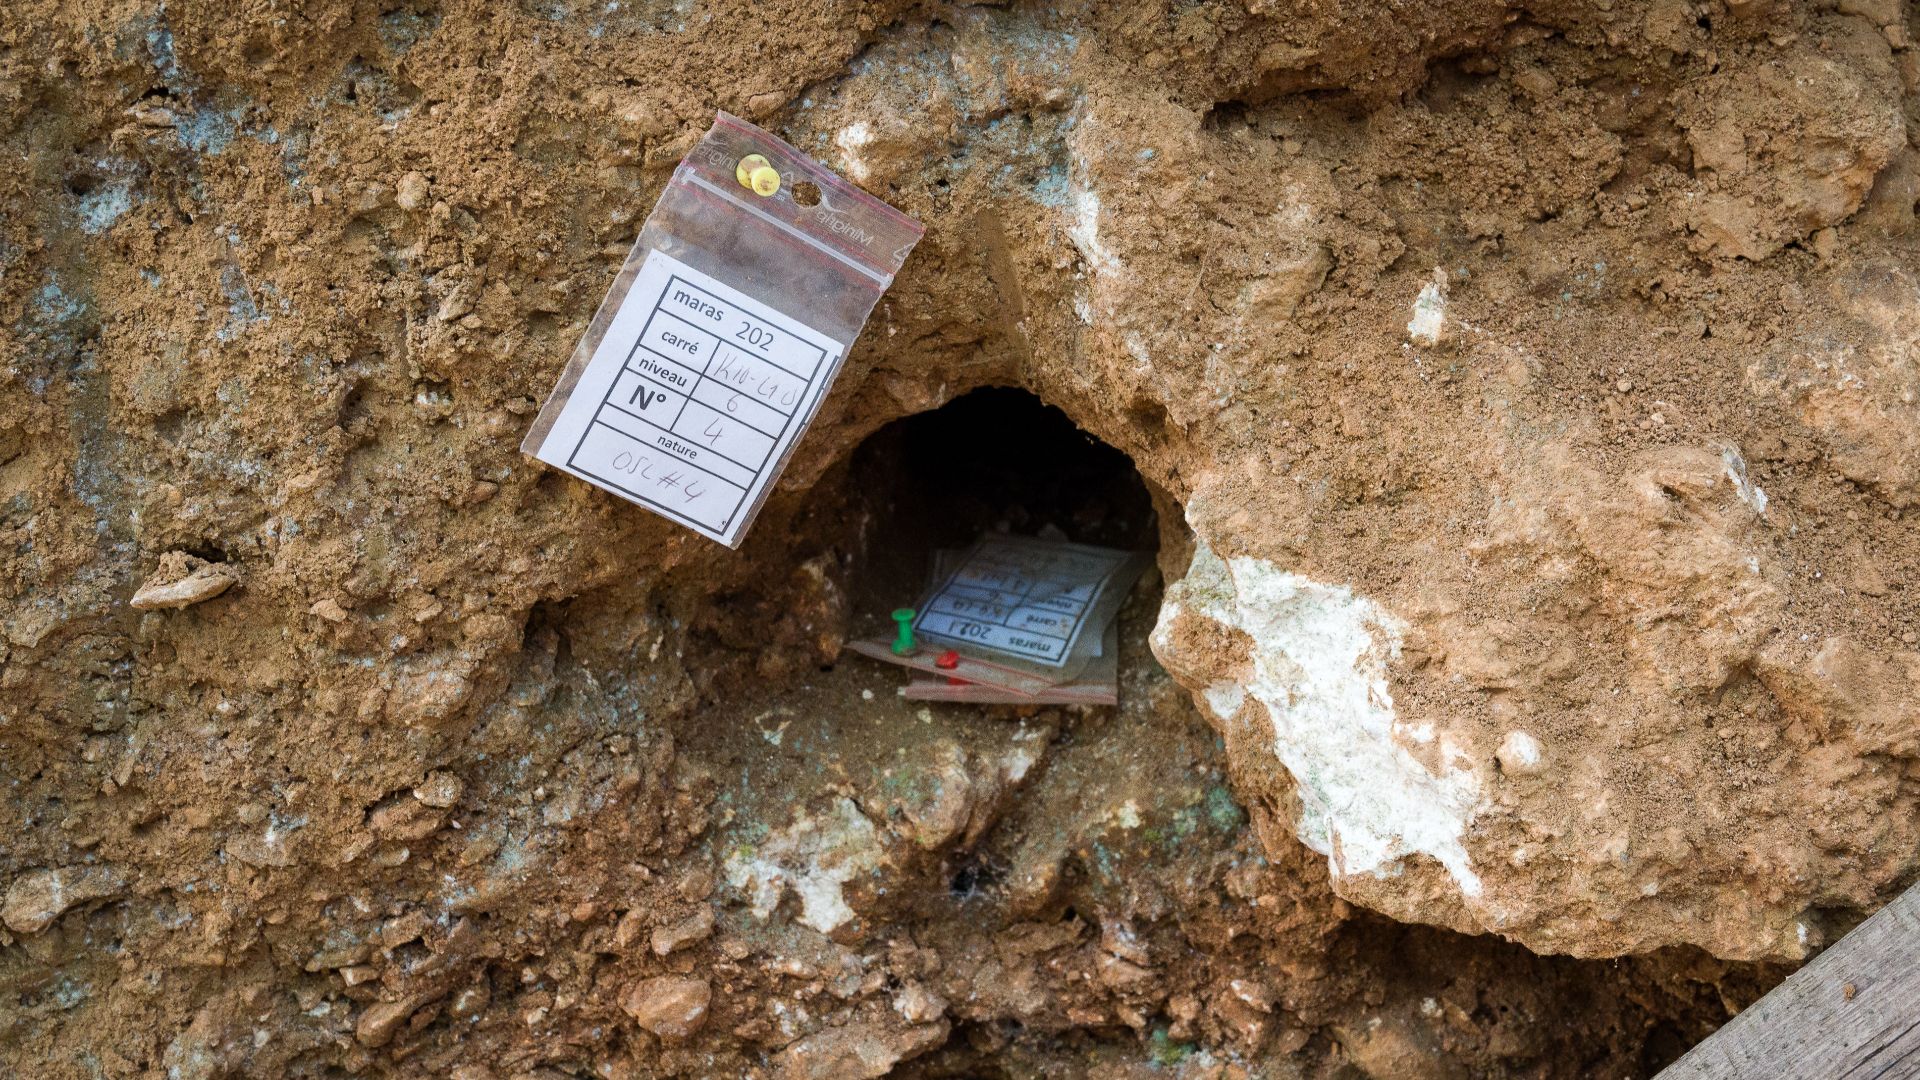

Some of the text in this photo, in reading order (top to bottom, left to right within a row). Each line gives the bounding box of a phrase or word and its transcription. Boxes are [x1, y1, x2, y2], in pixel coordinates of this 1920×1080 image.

[673, 288, 775, 352] maras 202
[660, 330, 699, 355] carré
[638, 357, 688, 388] niveau
[628, 384, 667, 411] N°
[726, 393, 743, 413] 6
[703, 417, 724, 447] 4
[656, 434, 698, 461] nature
[1008, 636, 1052, 652] maras
